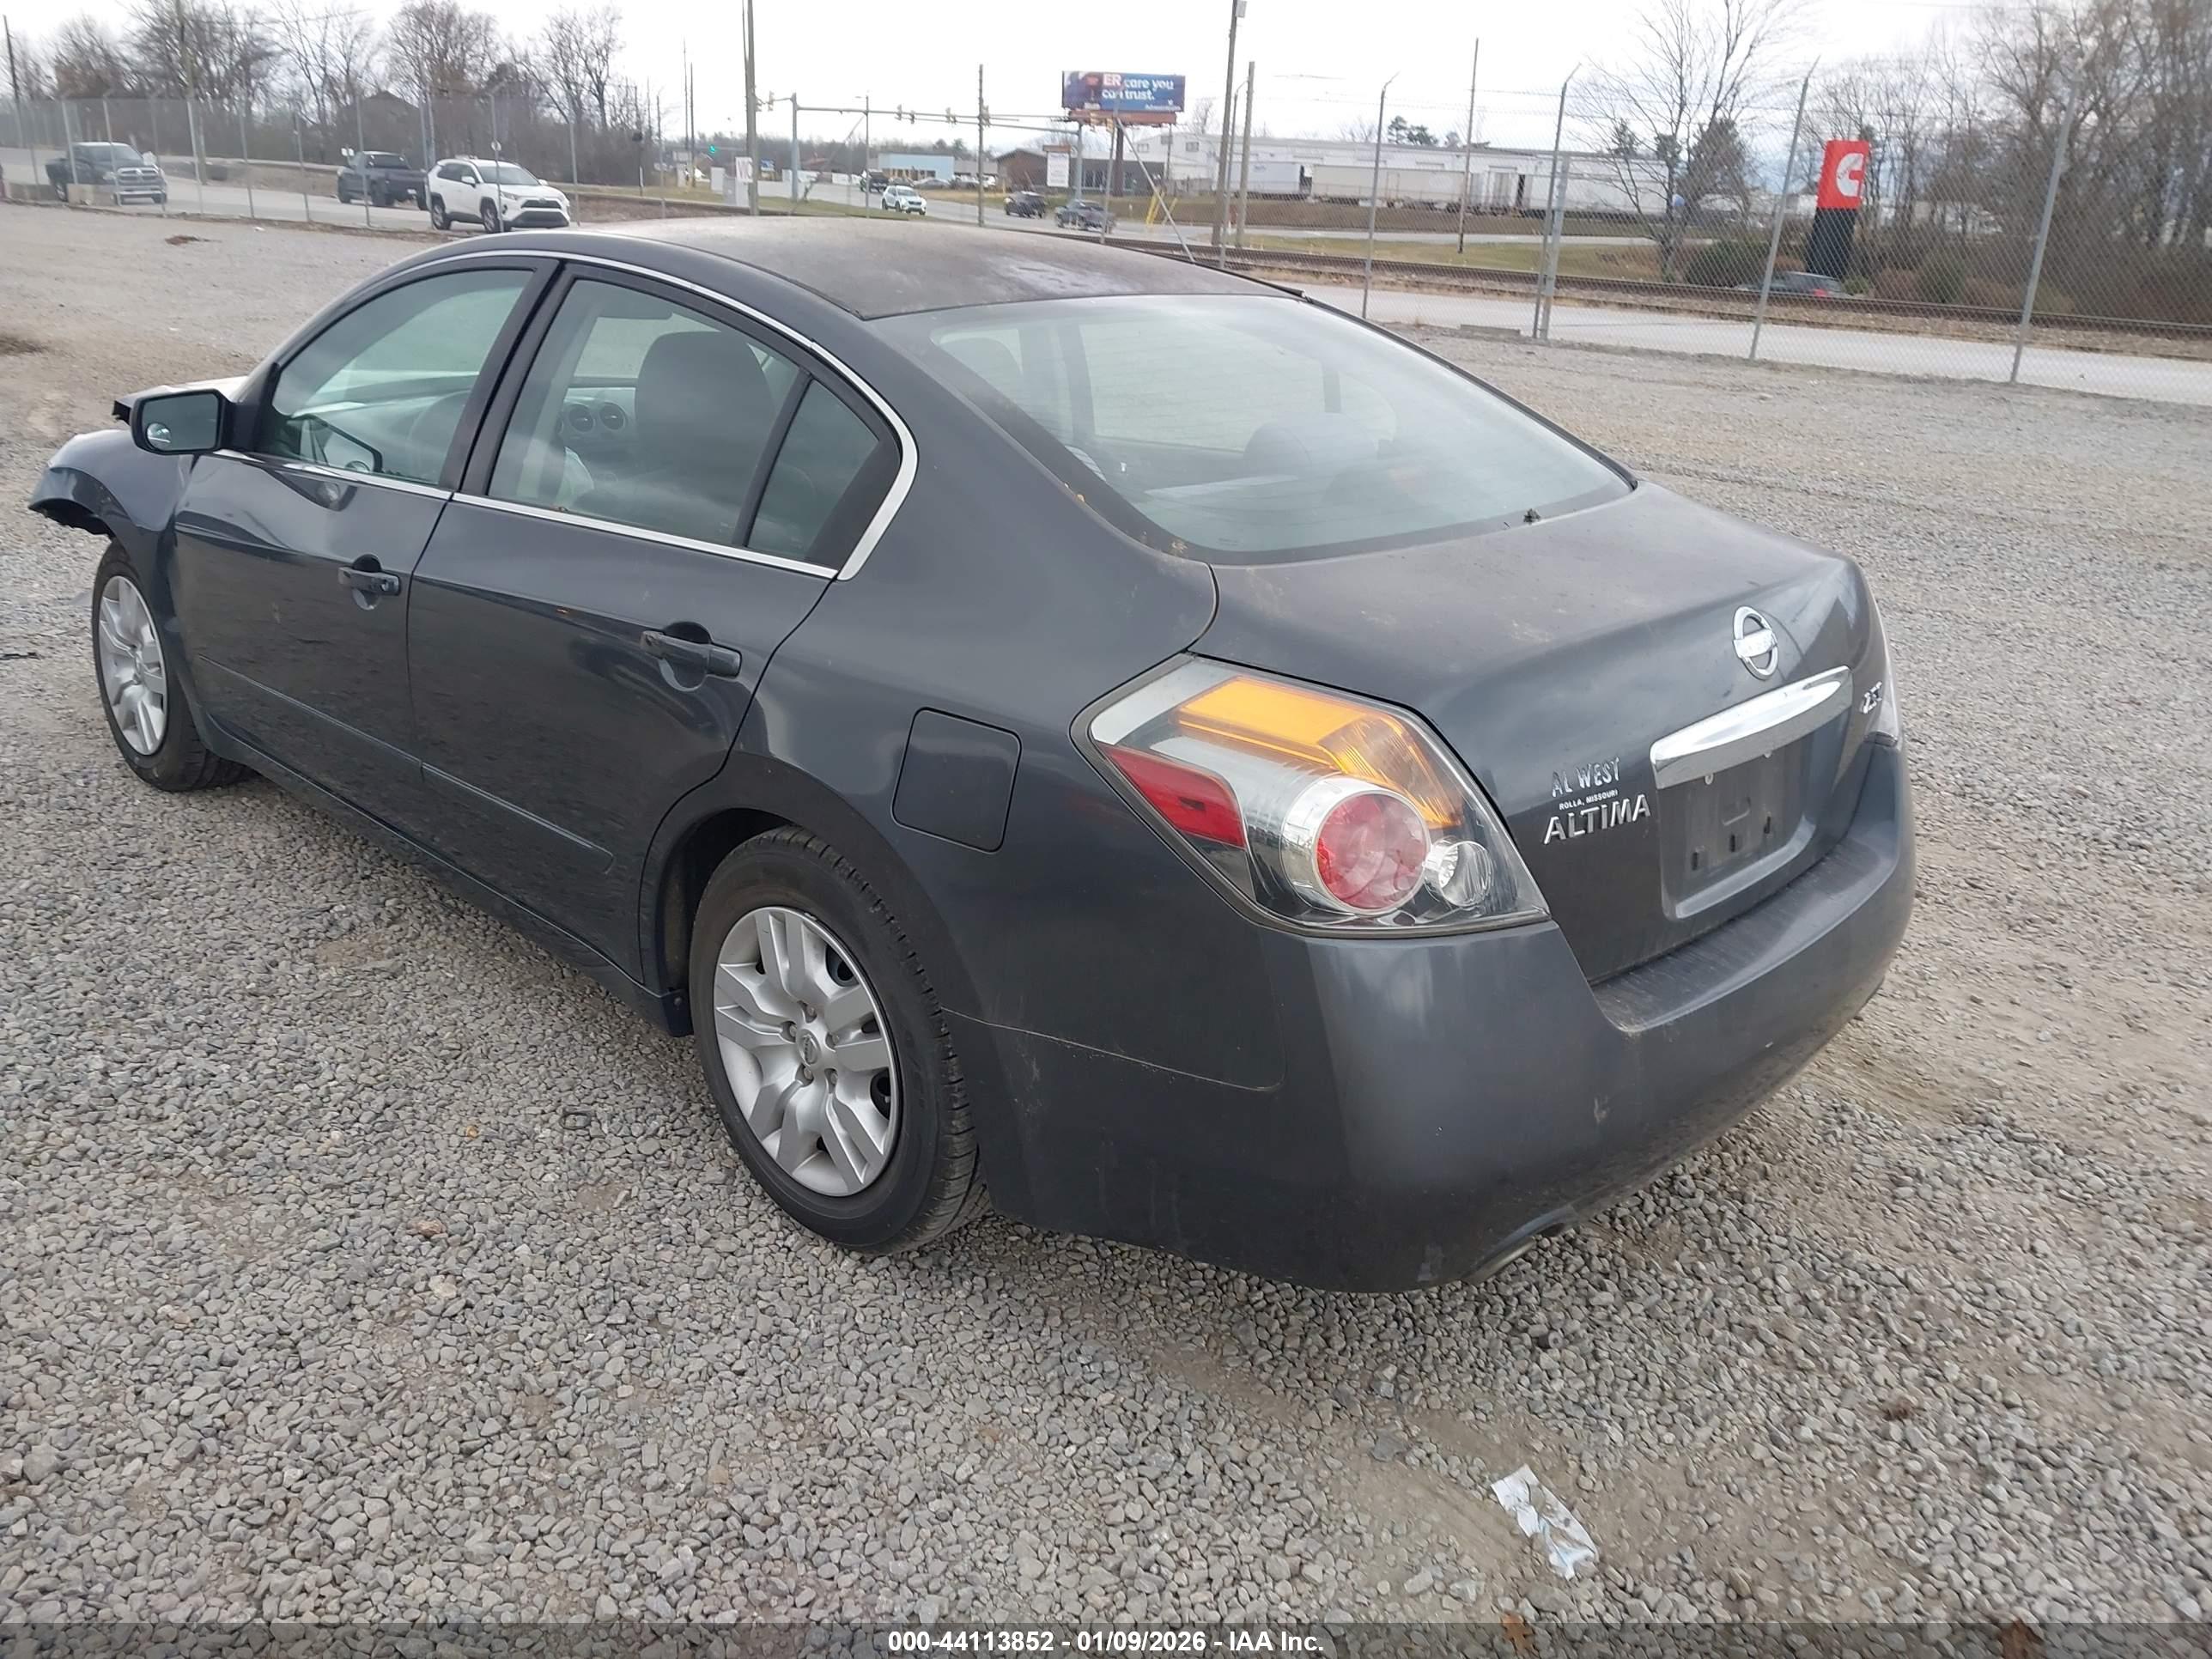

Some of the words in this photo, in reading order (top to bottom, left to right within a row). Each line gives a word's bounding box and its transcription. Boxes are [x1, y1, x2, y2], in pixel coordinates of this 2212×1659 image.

[1103, 74, 1121, 87] ER
[1123, 78, 1150, 88] care
[1152, 80, 1175, 91] you
[1124, 88, 1155, 100] trust.
[1552, 770, 1573, 798] AL
[1576, 757, 1620, 789] WEST
[1559, 798, 1585, 811] ROLLA,
[1586, 788, 1619, 805] MISSOURI
[1543, 793, 1651, 845] ALTIMA
